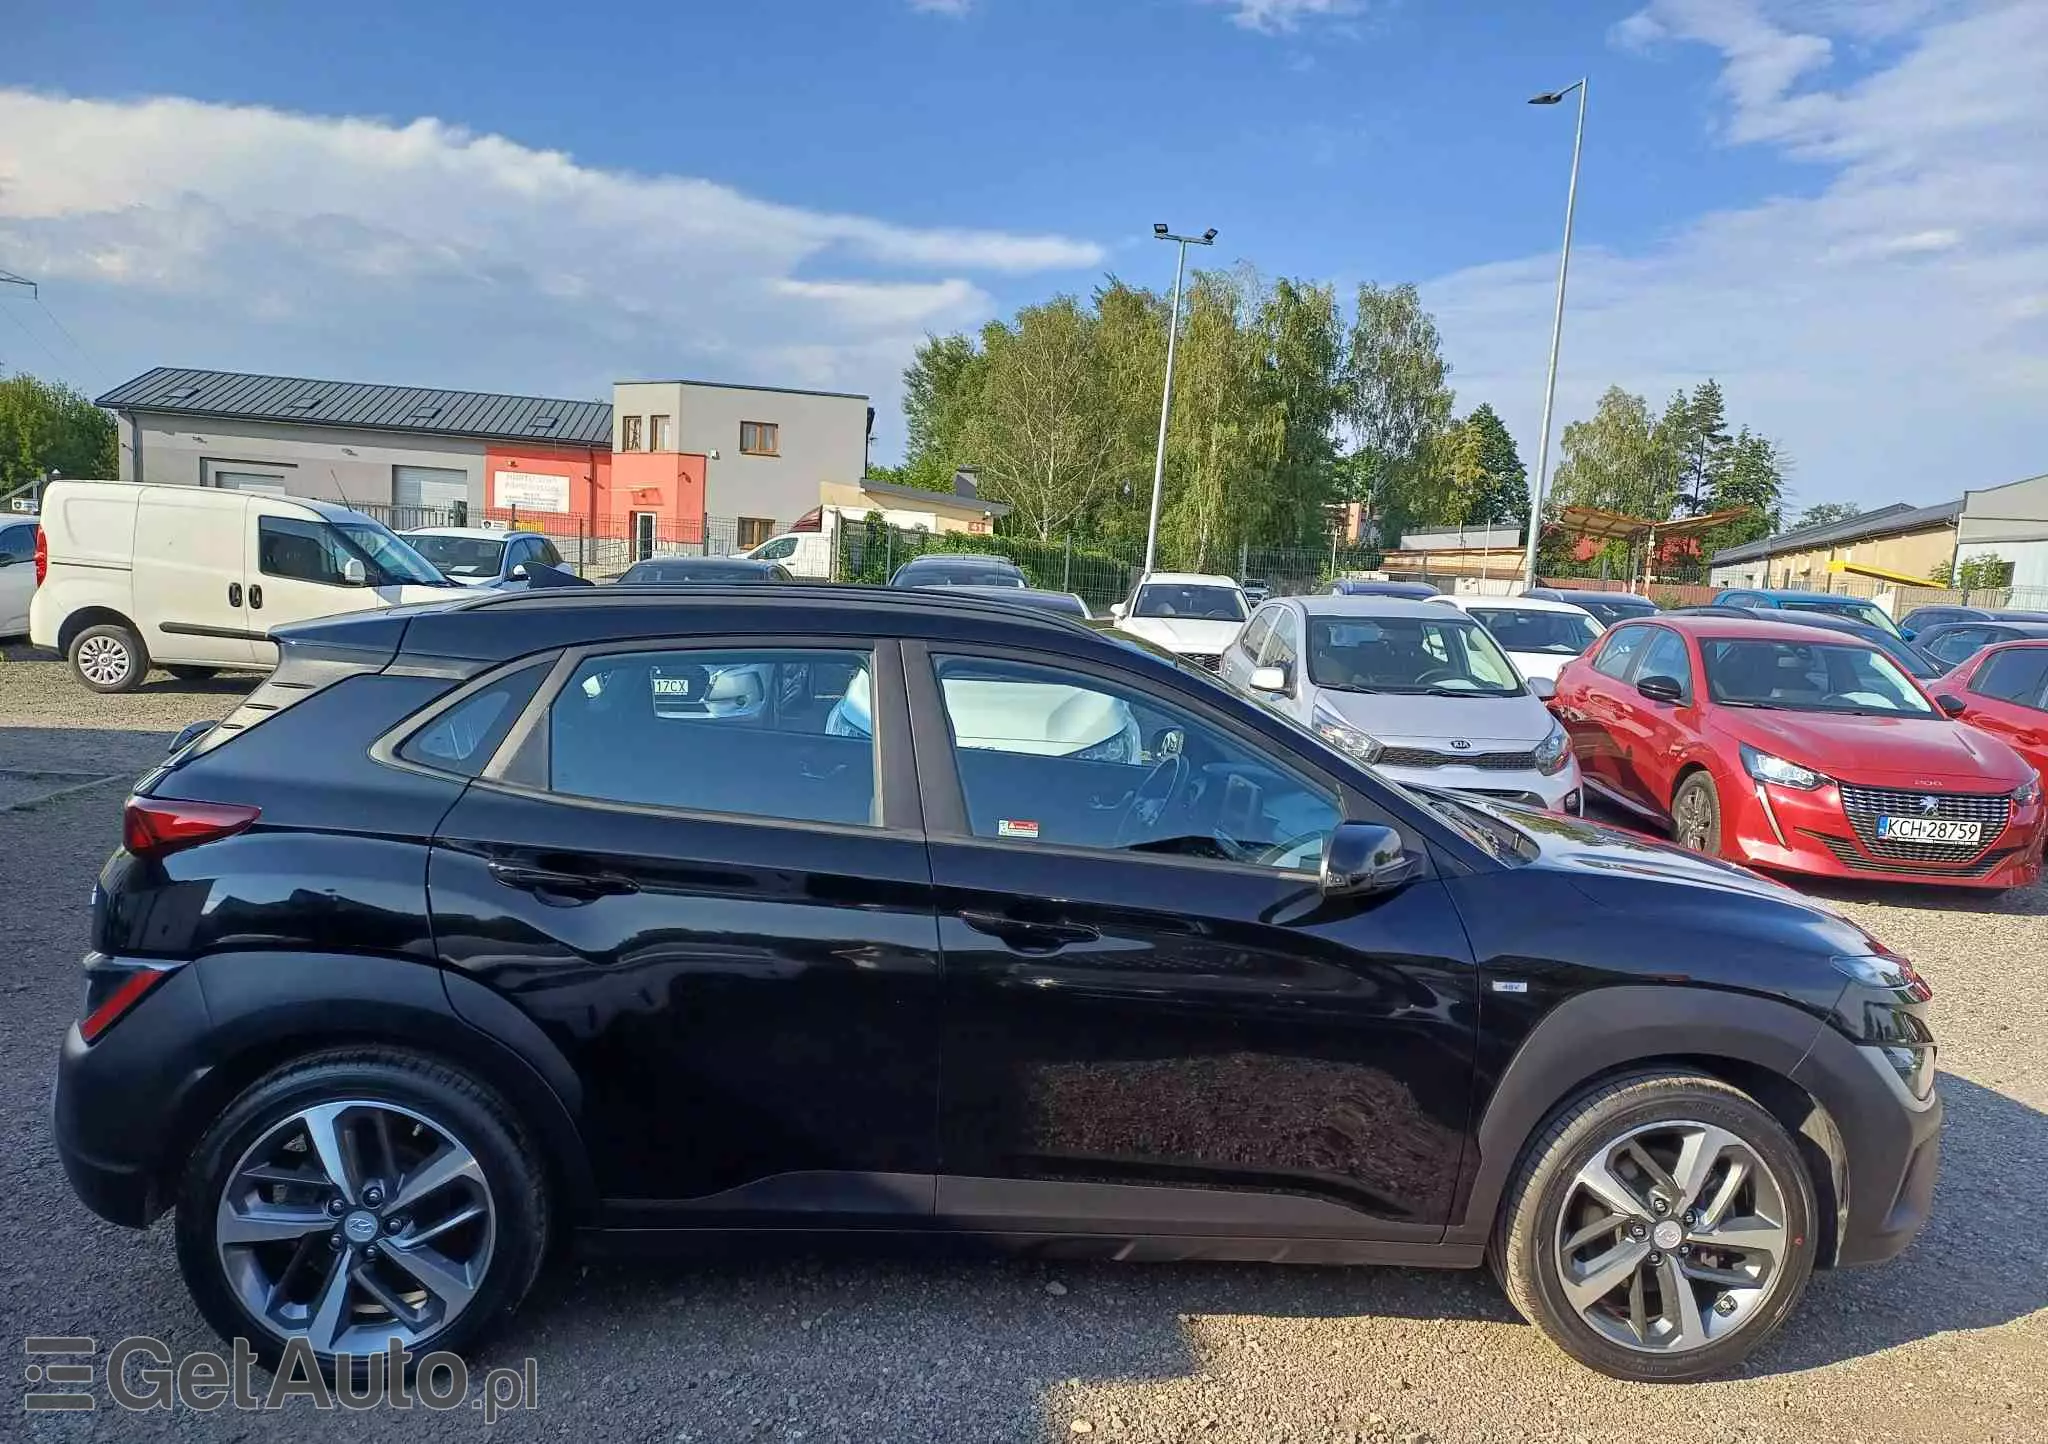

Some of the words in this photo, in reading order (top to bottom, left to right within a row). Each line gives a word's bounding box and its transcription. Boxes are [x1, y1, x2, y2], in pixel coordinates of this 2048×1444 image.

[657, 680, 686, 692] 17CX
[1452, 740, 1471, 749] KIA
[1887, 819, 1922, 837] KCH
[1926, 821, 1979, 840] 28759
